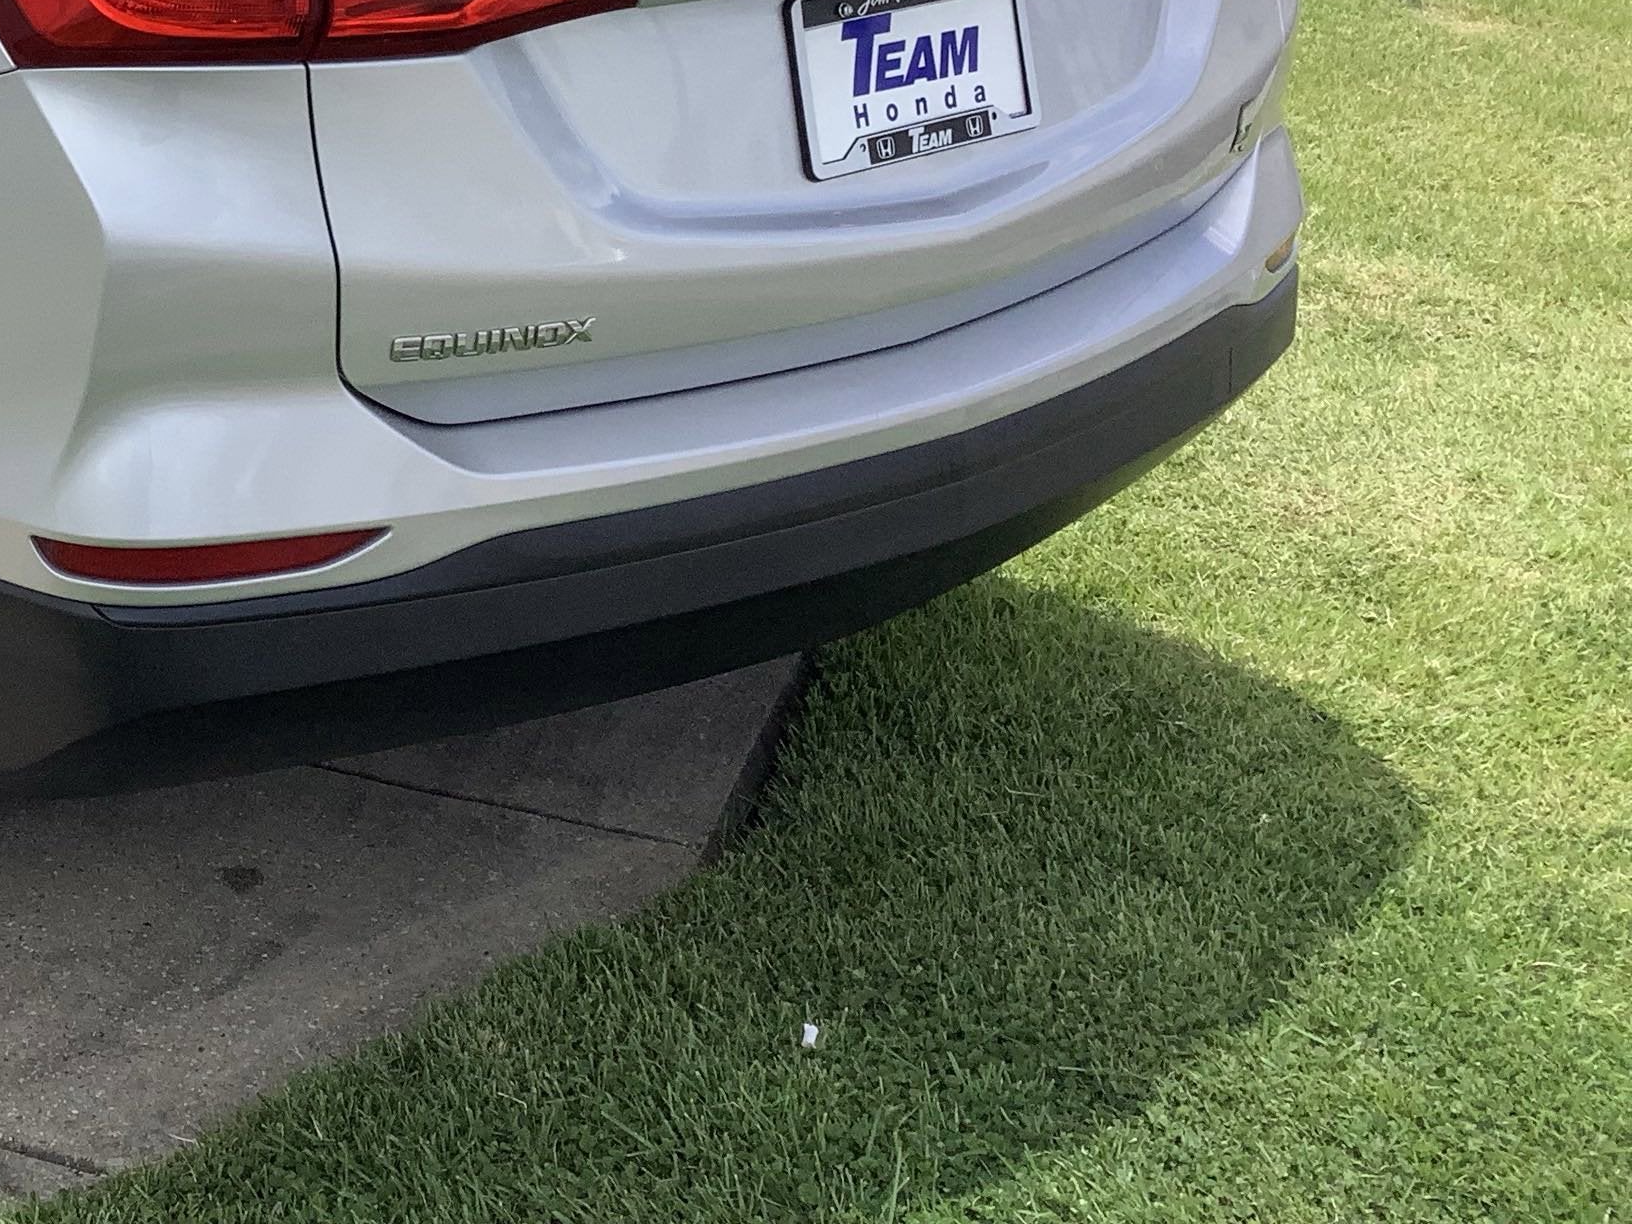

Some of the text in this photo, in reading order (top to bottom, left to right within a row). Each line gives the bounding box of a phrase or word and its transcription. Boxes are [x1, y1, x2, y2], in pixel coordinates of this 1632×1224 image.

[841, 12, 979, 97] TEAM
[853, 85, 986, 129] Honda
[908, 127, 953, 154] TEAM
[389, 317, 597, 362] EQUINOX
